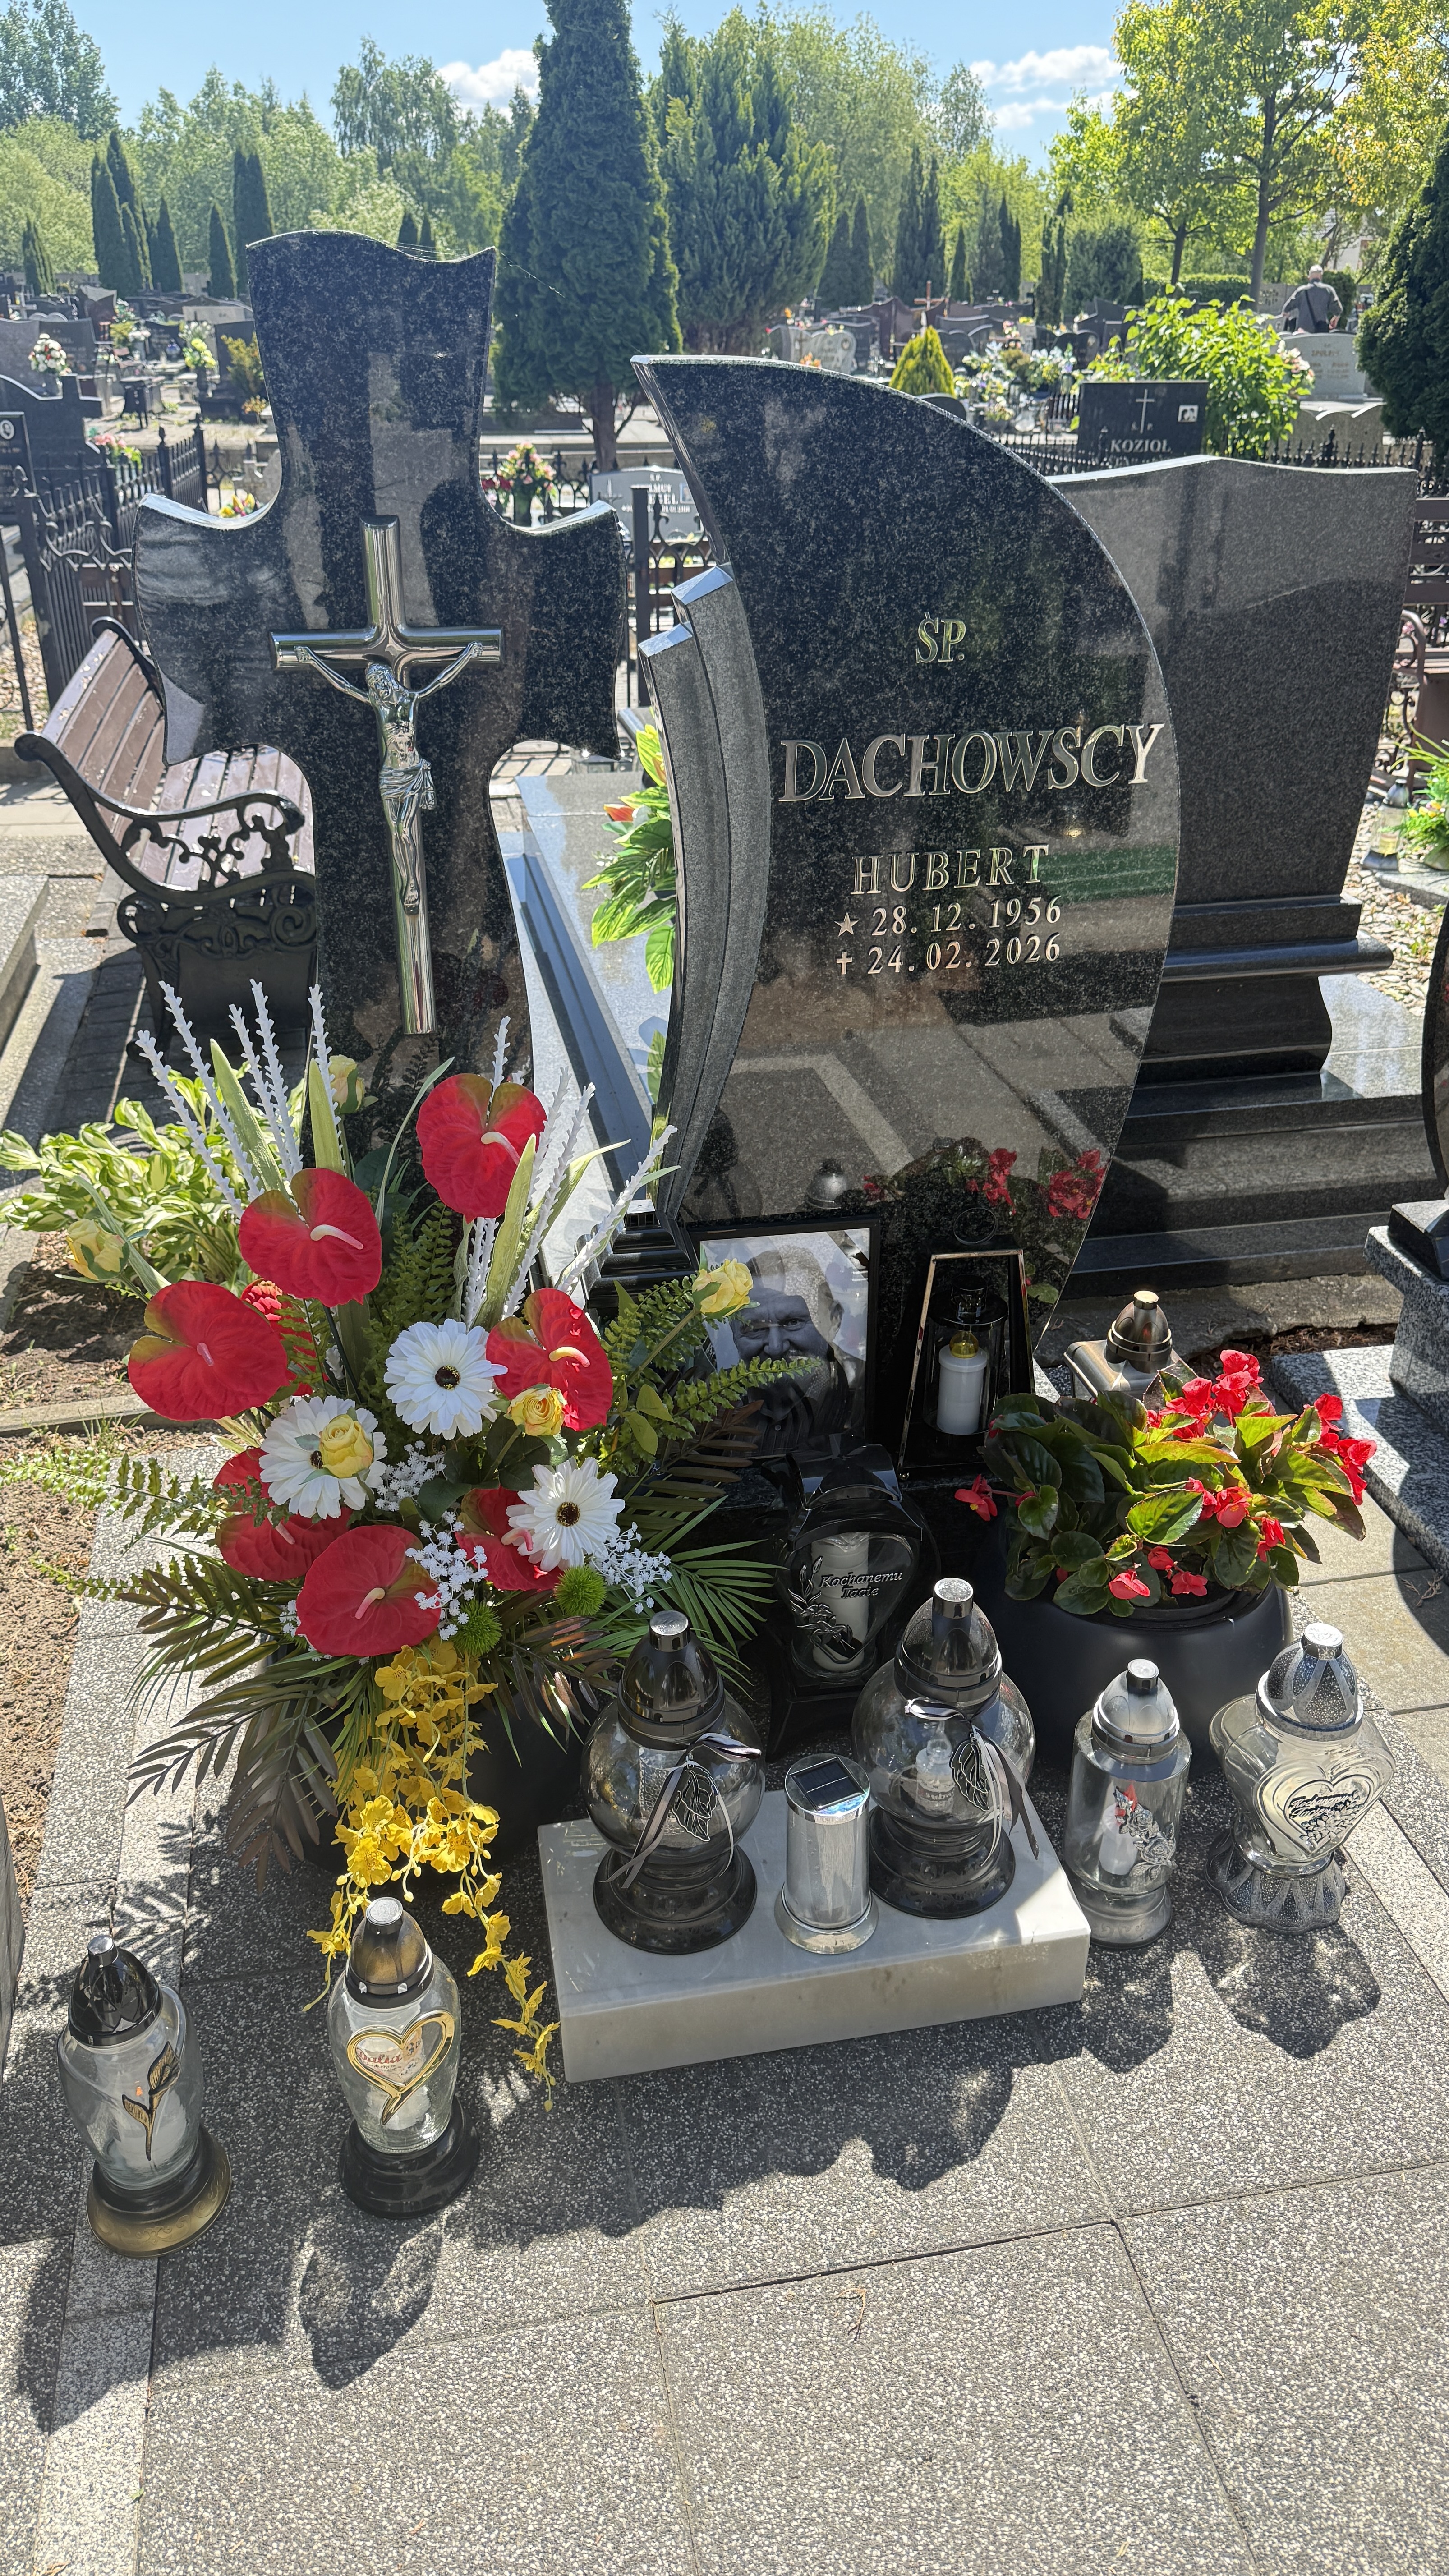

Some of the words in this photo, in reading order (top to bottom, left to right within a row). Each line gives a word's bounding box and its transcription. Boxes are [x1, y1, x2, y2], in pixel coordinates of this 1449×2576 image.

[778, 723, 1165, 802] DACHOWSCY
[850, 844, 1049, 895] HUBERT
[989, 895, 1062, 928] 1956
[984, 932, 1061, 966] 2026
[819, 1572, 902, 1588] Kochanemu
[841, 1586, 879, 1599] Tacie
